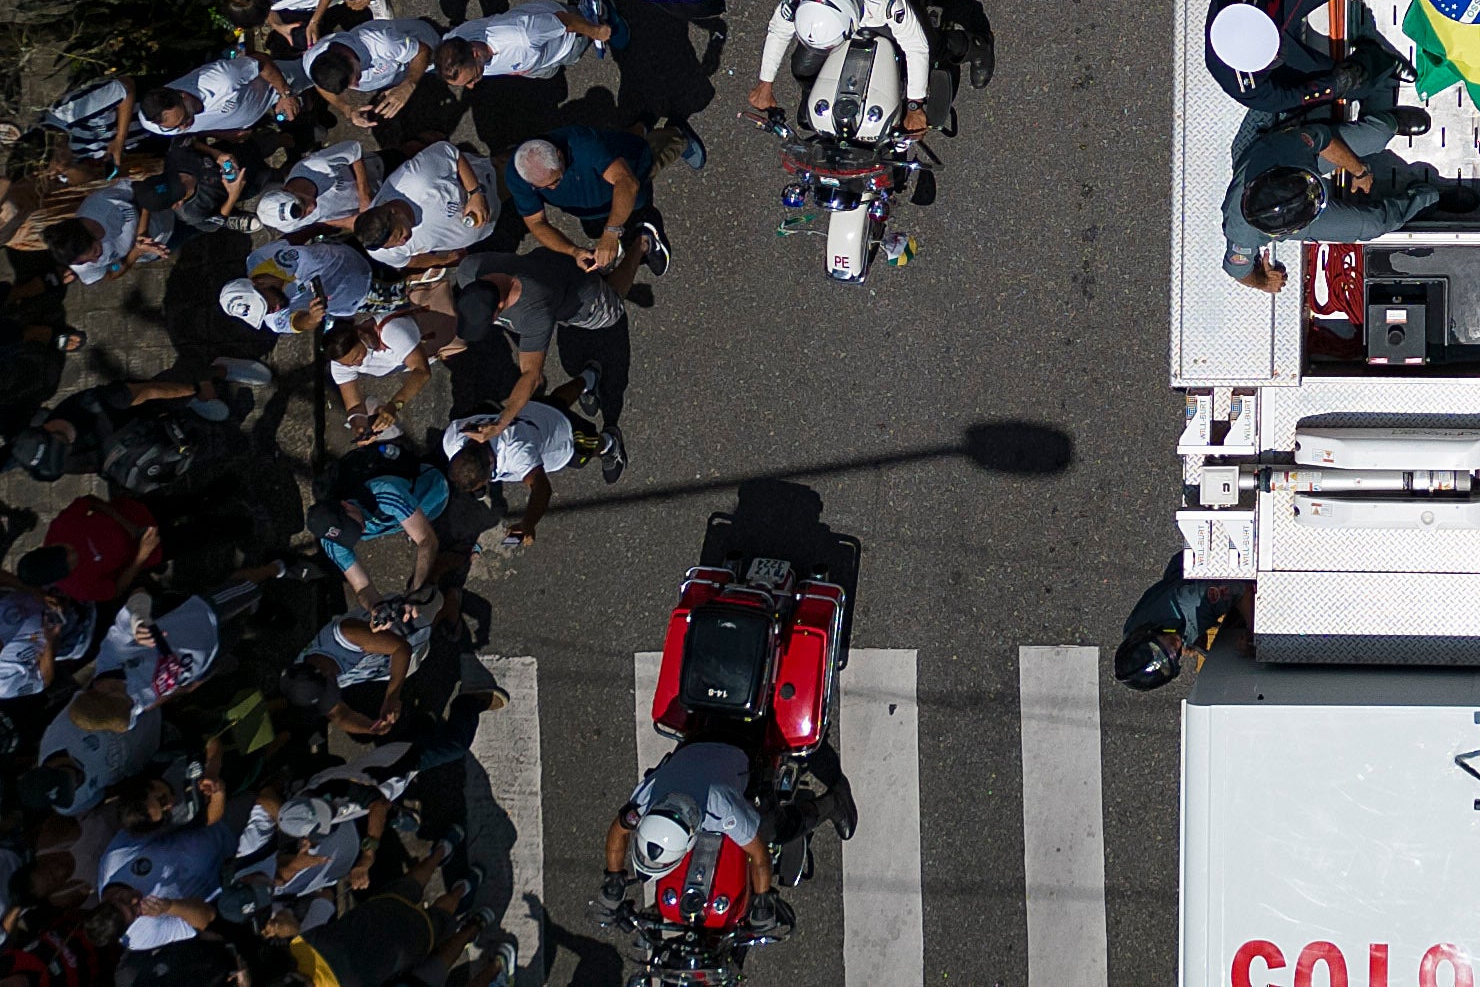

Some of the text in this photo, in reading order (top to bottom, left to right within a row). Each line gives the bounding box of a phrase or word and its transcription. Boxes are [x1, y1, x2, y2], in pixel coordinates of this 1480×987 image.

[834, 256, 850, 268] PE
[1199, 399, 1207, 440] WILL-BURT
[1198, 524, 1206, 566] WILL-BURT
